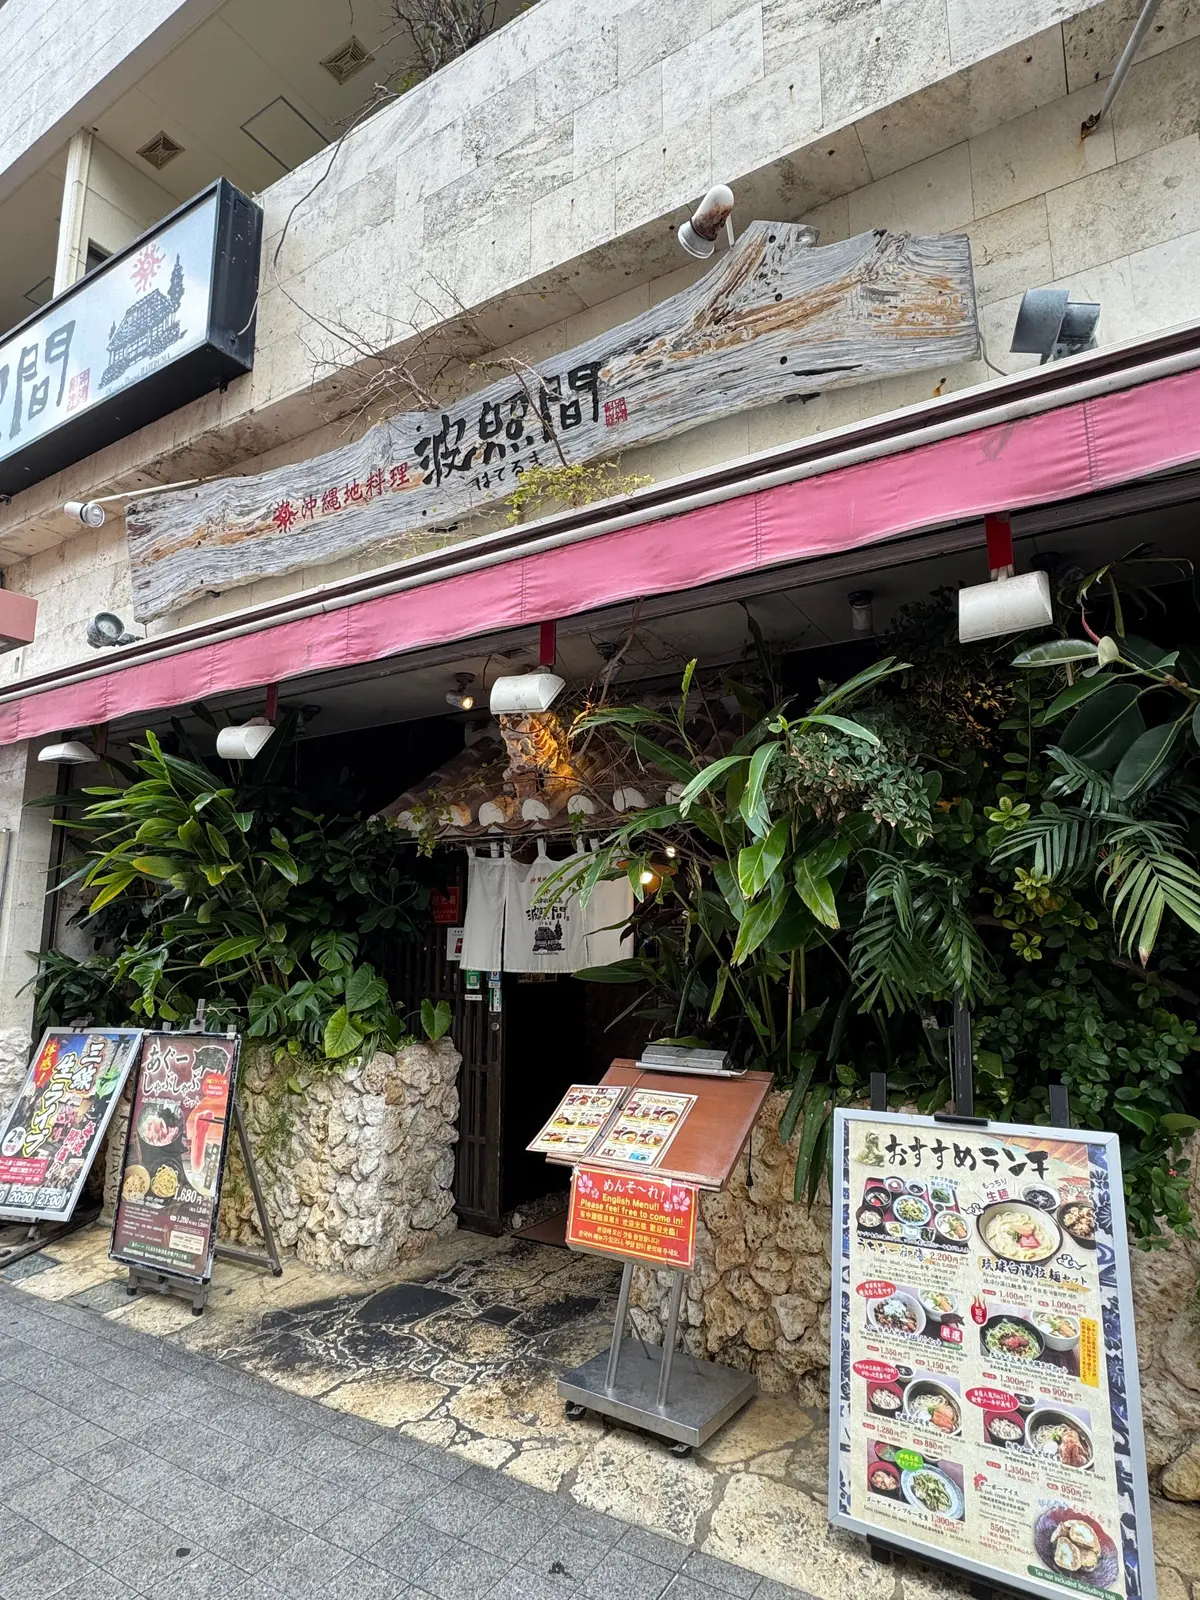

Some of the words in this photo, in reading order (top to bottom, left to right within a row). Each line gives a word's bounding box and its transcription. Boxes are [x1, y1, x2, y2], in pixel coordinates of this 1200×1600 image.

[0, 320, 76, 441] 間
[414, 361, 602, 488] 波照間
[301, 461, 411, 521] 沖縄地料理
[146, 1044, 190, 1073] あぐー
[143, 1070, 204, 1096] しゃぶしゃぶ
[885, 1134, 1050, 1181] おすすめランチ
[982, 1178, 1008, 1190] もっちり
[8, 1191, 33, 1203] 20:00
[36, 1193, 62, 1207] 21:00
[602, 1193, 631, 1206] English
[632, 1198, 660, 1211] Menu!!
[580, 1198, 604, 1211] Please
[605, 1202, 620, 1213] feel
[622, 1206, 638, 1217] free
[649, 1213, 671, 1224] come
[673, 1216, 684, 1226] in!
[929, 1251, 960, 1265] 2,200円
[1051, 1300, 1077, 1311] 1,000円
[927, 1361, 951, 1372] 1,150円
[1000, 1374, 1025, 1386] 1,300円
[1053, 1388, 1074, 1399] 900円
[876, 1425, 900, 1437] 1,280円
[924, 1440, 944, 1452] 880円
[1004, 1463, 1030, 1477] 1,350円
[1060, 1484, 1082, 1497] 950円
[866, 1496, 929, 1521] ゴーヤーチャンプルー定食
[931, 1514, 955, 1528] 1,300円
[990, 1522, 1011, 1537] 550円
[1035, 1569, 1043, 1577] Tax
[1044, 1572, 1054, 1581] not
[1055, 1574, 1077, 1589] included
